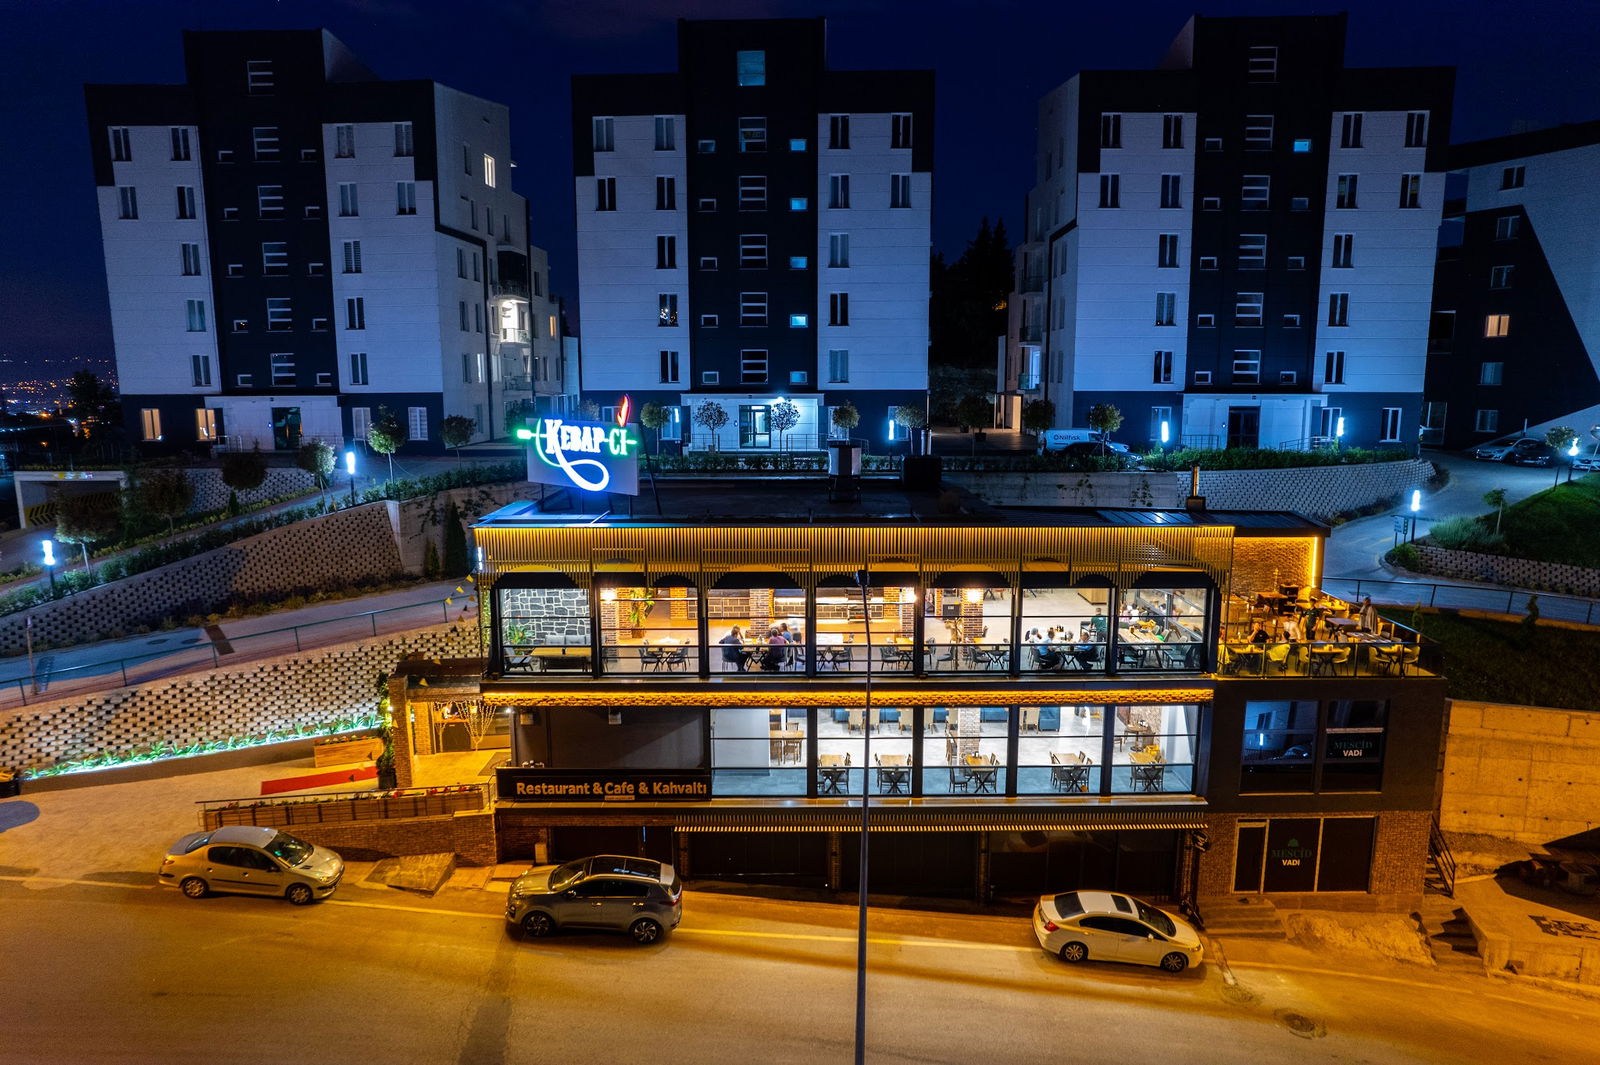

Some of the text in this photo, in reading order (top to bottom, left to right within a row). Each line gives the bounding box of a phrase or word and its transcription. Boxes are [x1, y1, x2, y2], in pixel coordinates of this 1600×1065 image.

[516, 782, 590, 795] Restaurant
[592, 782, 603, 795] &
[604, 782, 635, 795] Cafe
[638, 782, 649, 795] &
